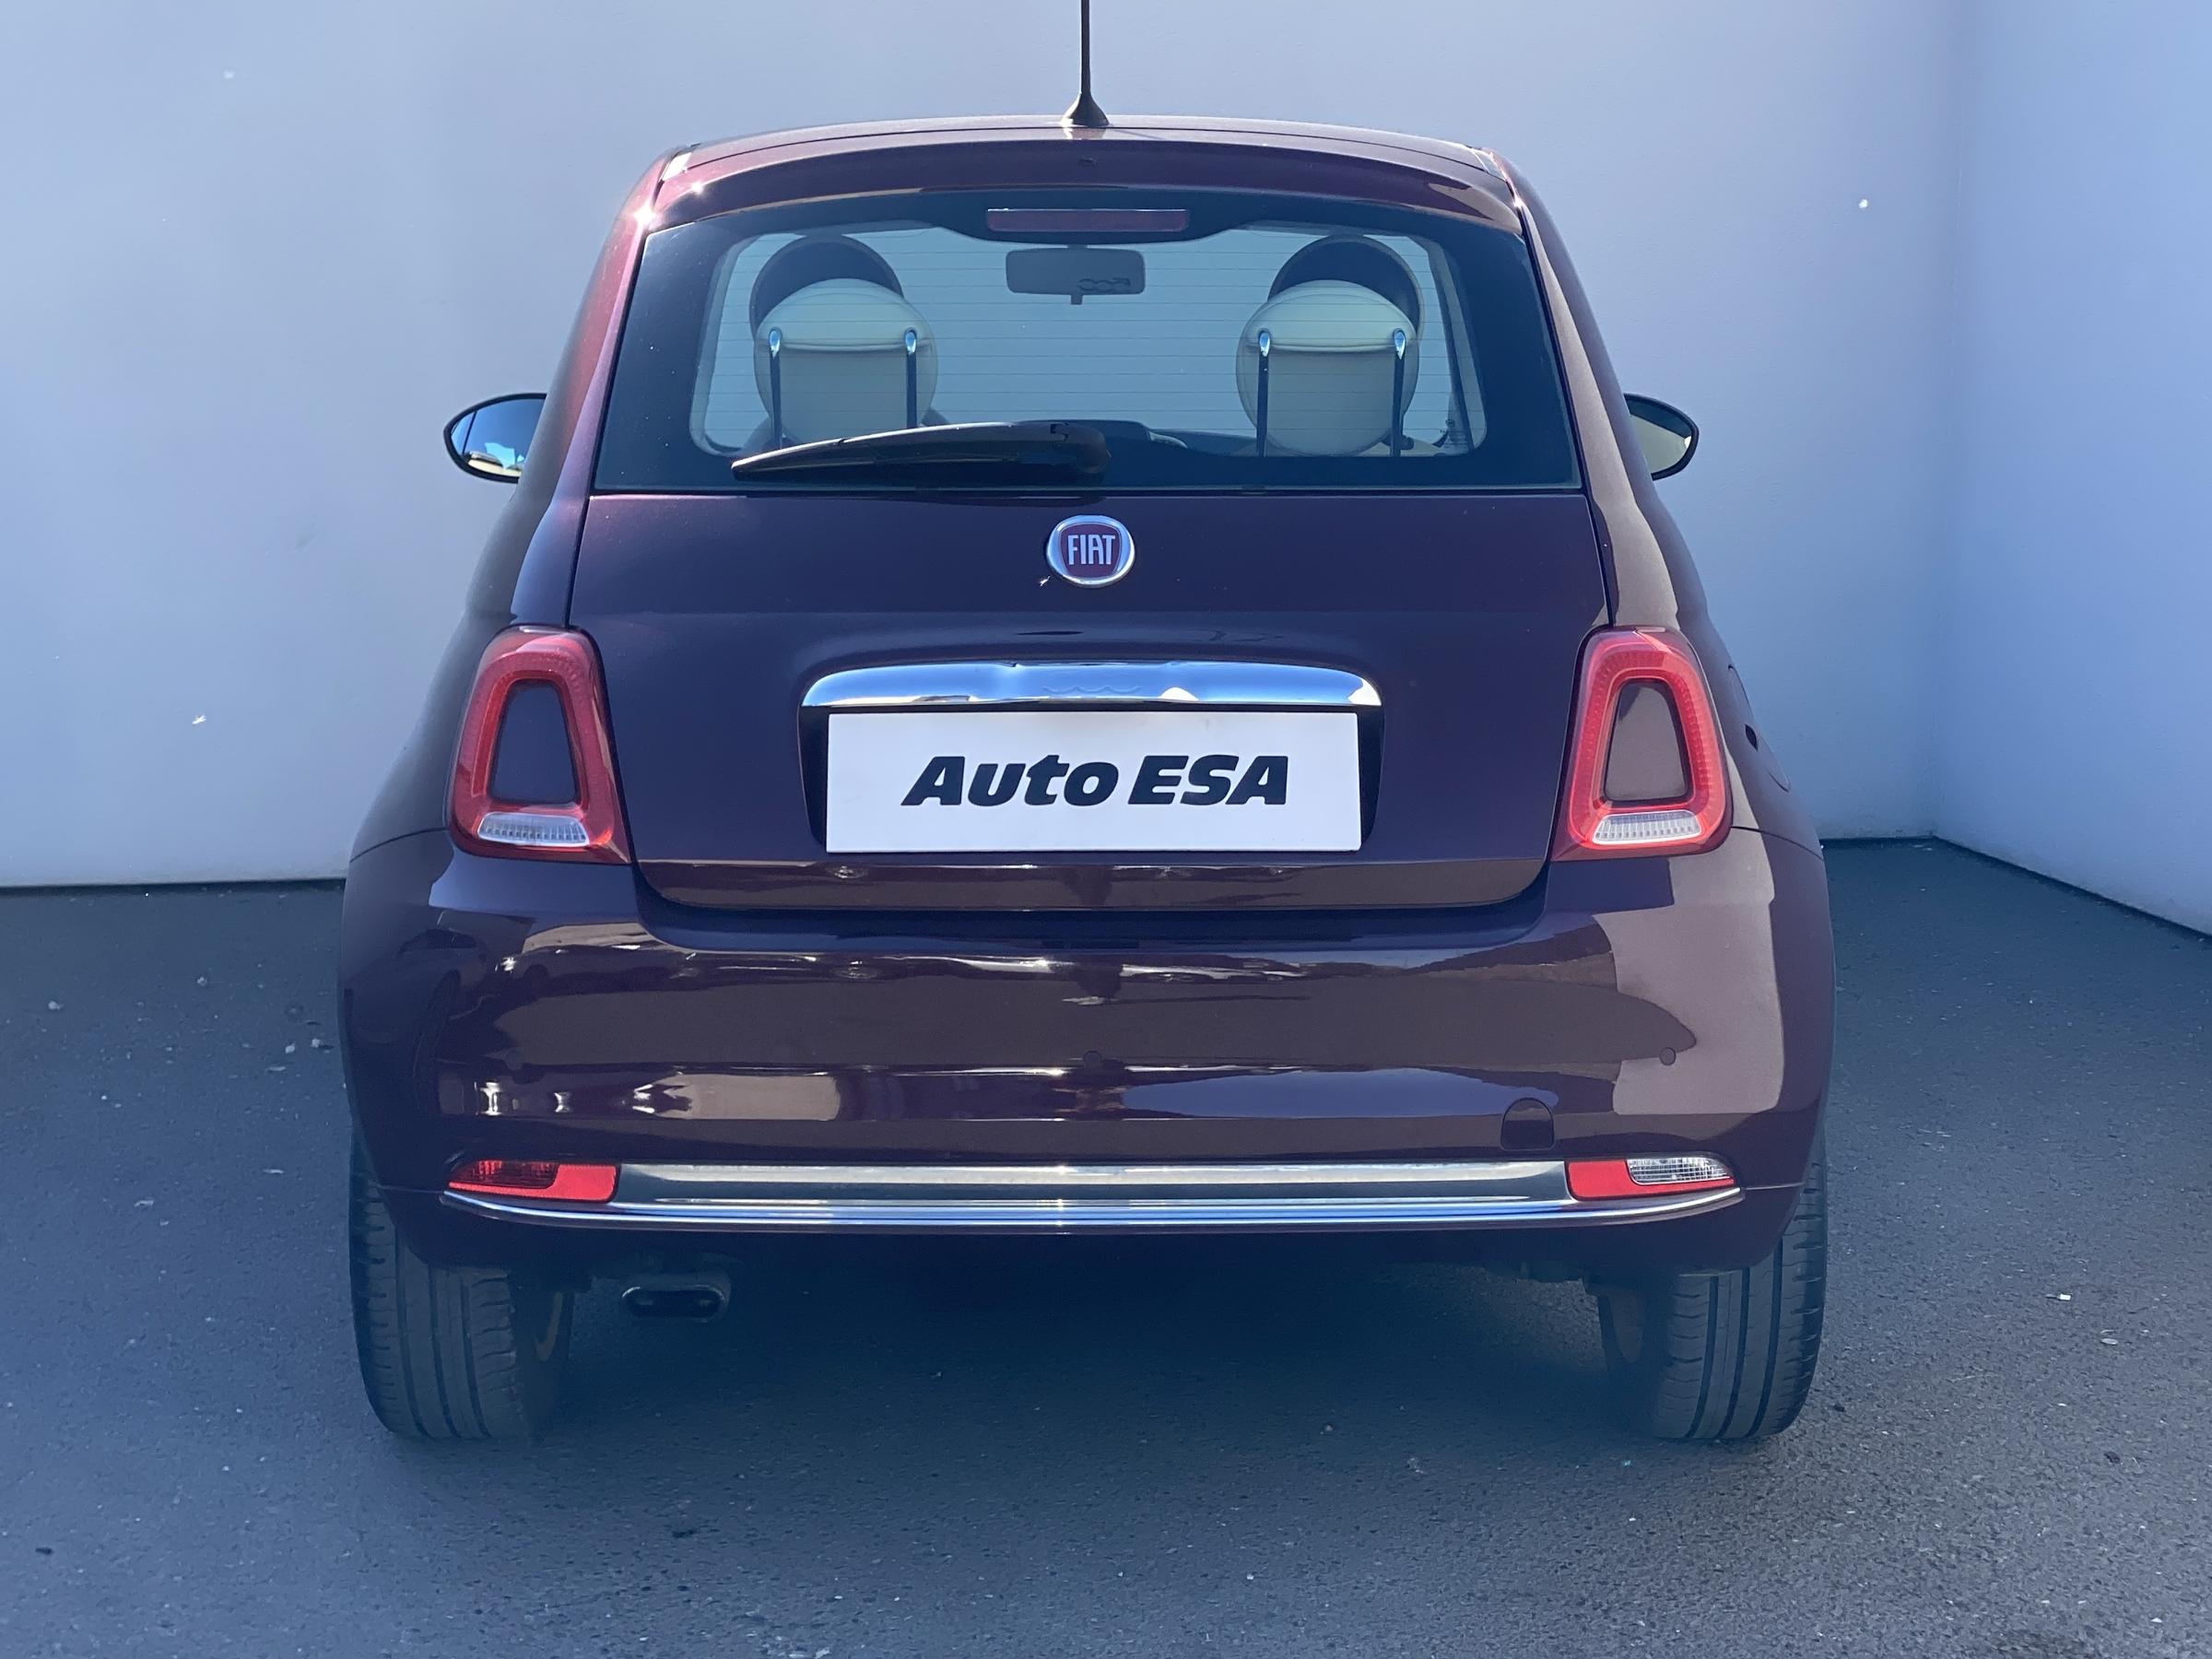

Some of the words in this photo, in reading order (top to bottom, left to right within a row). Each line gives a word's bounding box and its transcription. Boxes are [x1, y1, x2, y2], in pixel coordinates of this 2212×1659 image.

[1067, 534, 1116, 566] FIAT
[901, 755, 1119, 807] Auto
[1128, 754, 1288, 806] ESA
